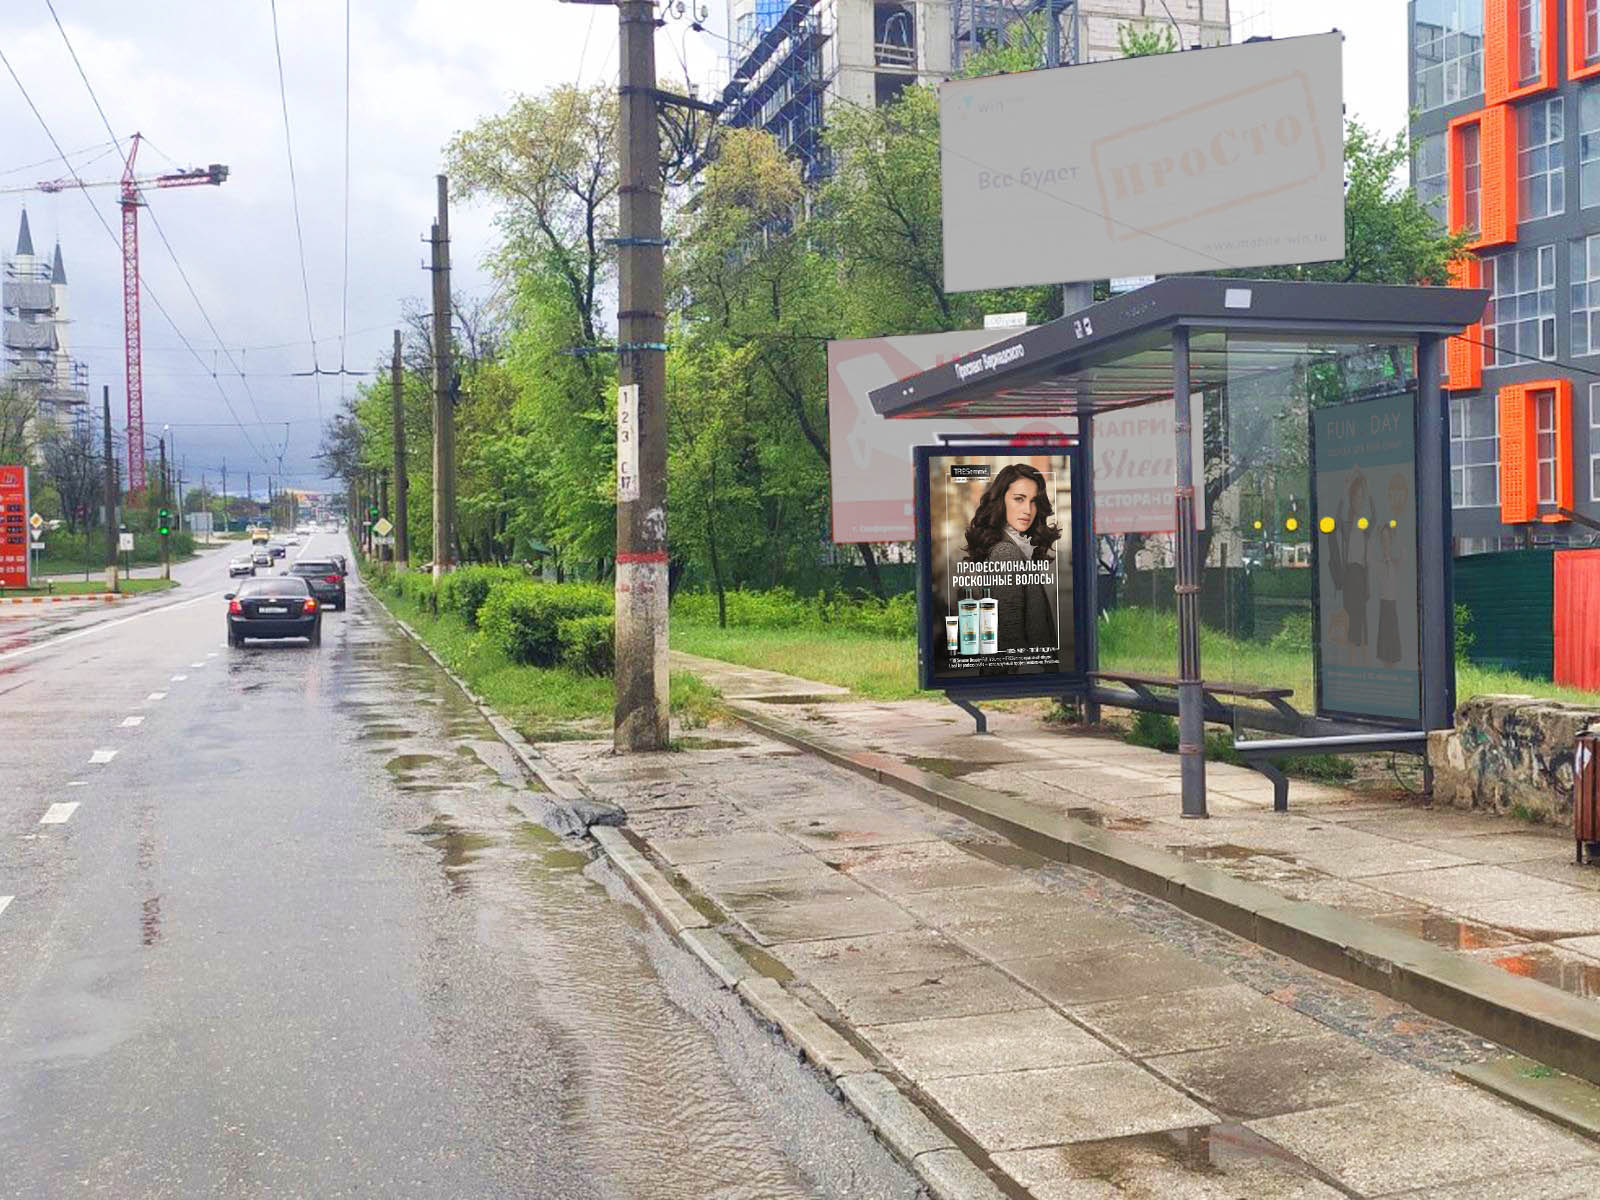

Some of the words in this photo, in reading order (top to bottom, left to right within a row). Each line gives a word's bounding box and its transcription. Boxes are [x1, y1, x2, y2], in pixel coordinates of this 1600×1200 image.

[622, 412, 629, 423] 2
[622, 431, 629, 442] 3
[956, 559, 1050, 574] ПРОФЕССИОНАЛЬНО
[952, 574, 1013, 588] РОСКОШНЫЕ
[1015, 573, 1055, 586] ВОЛОСЫ
